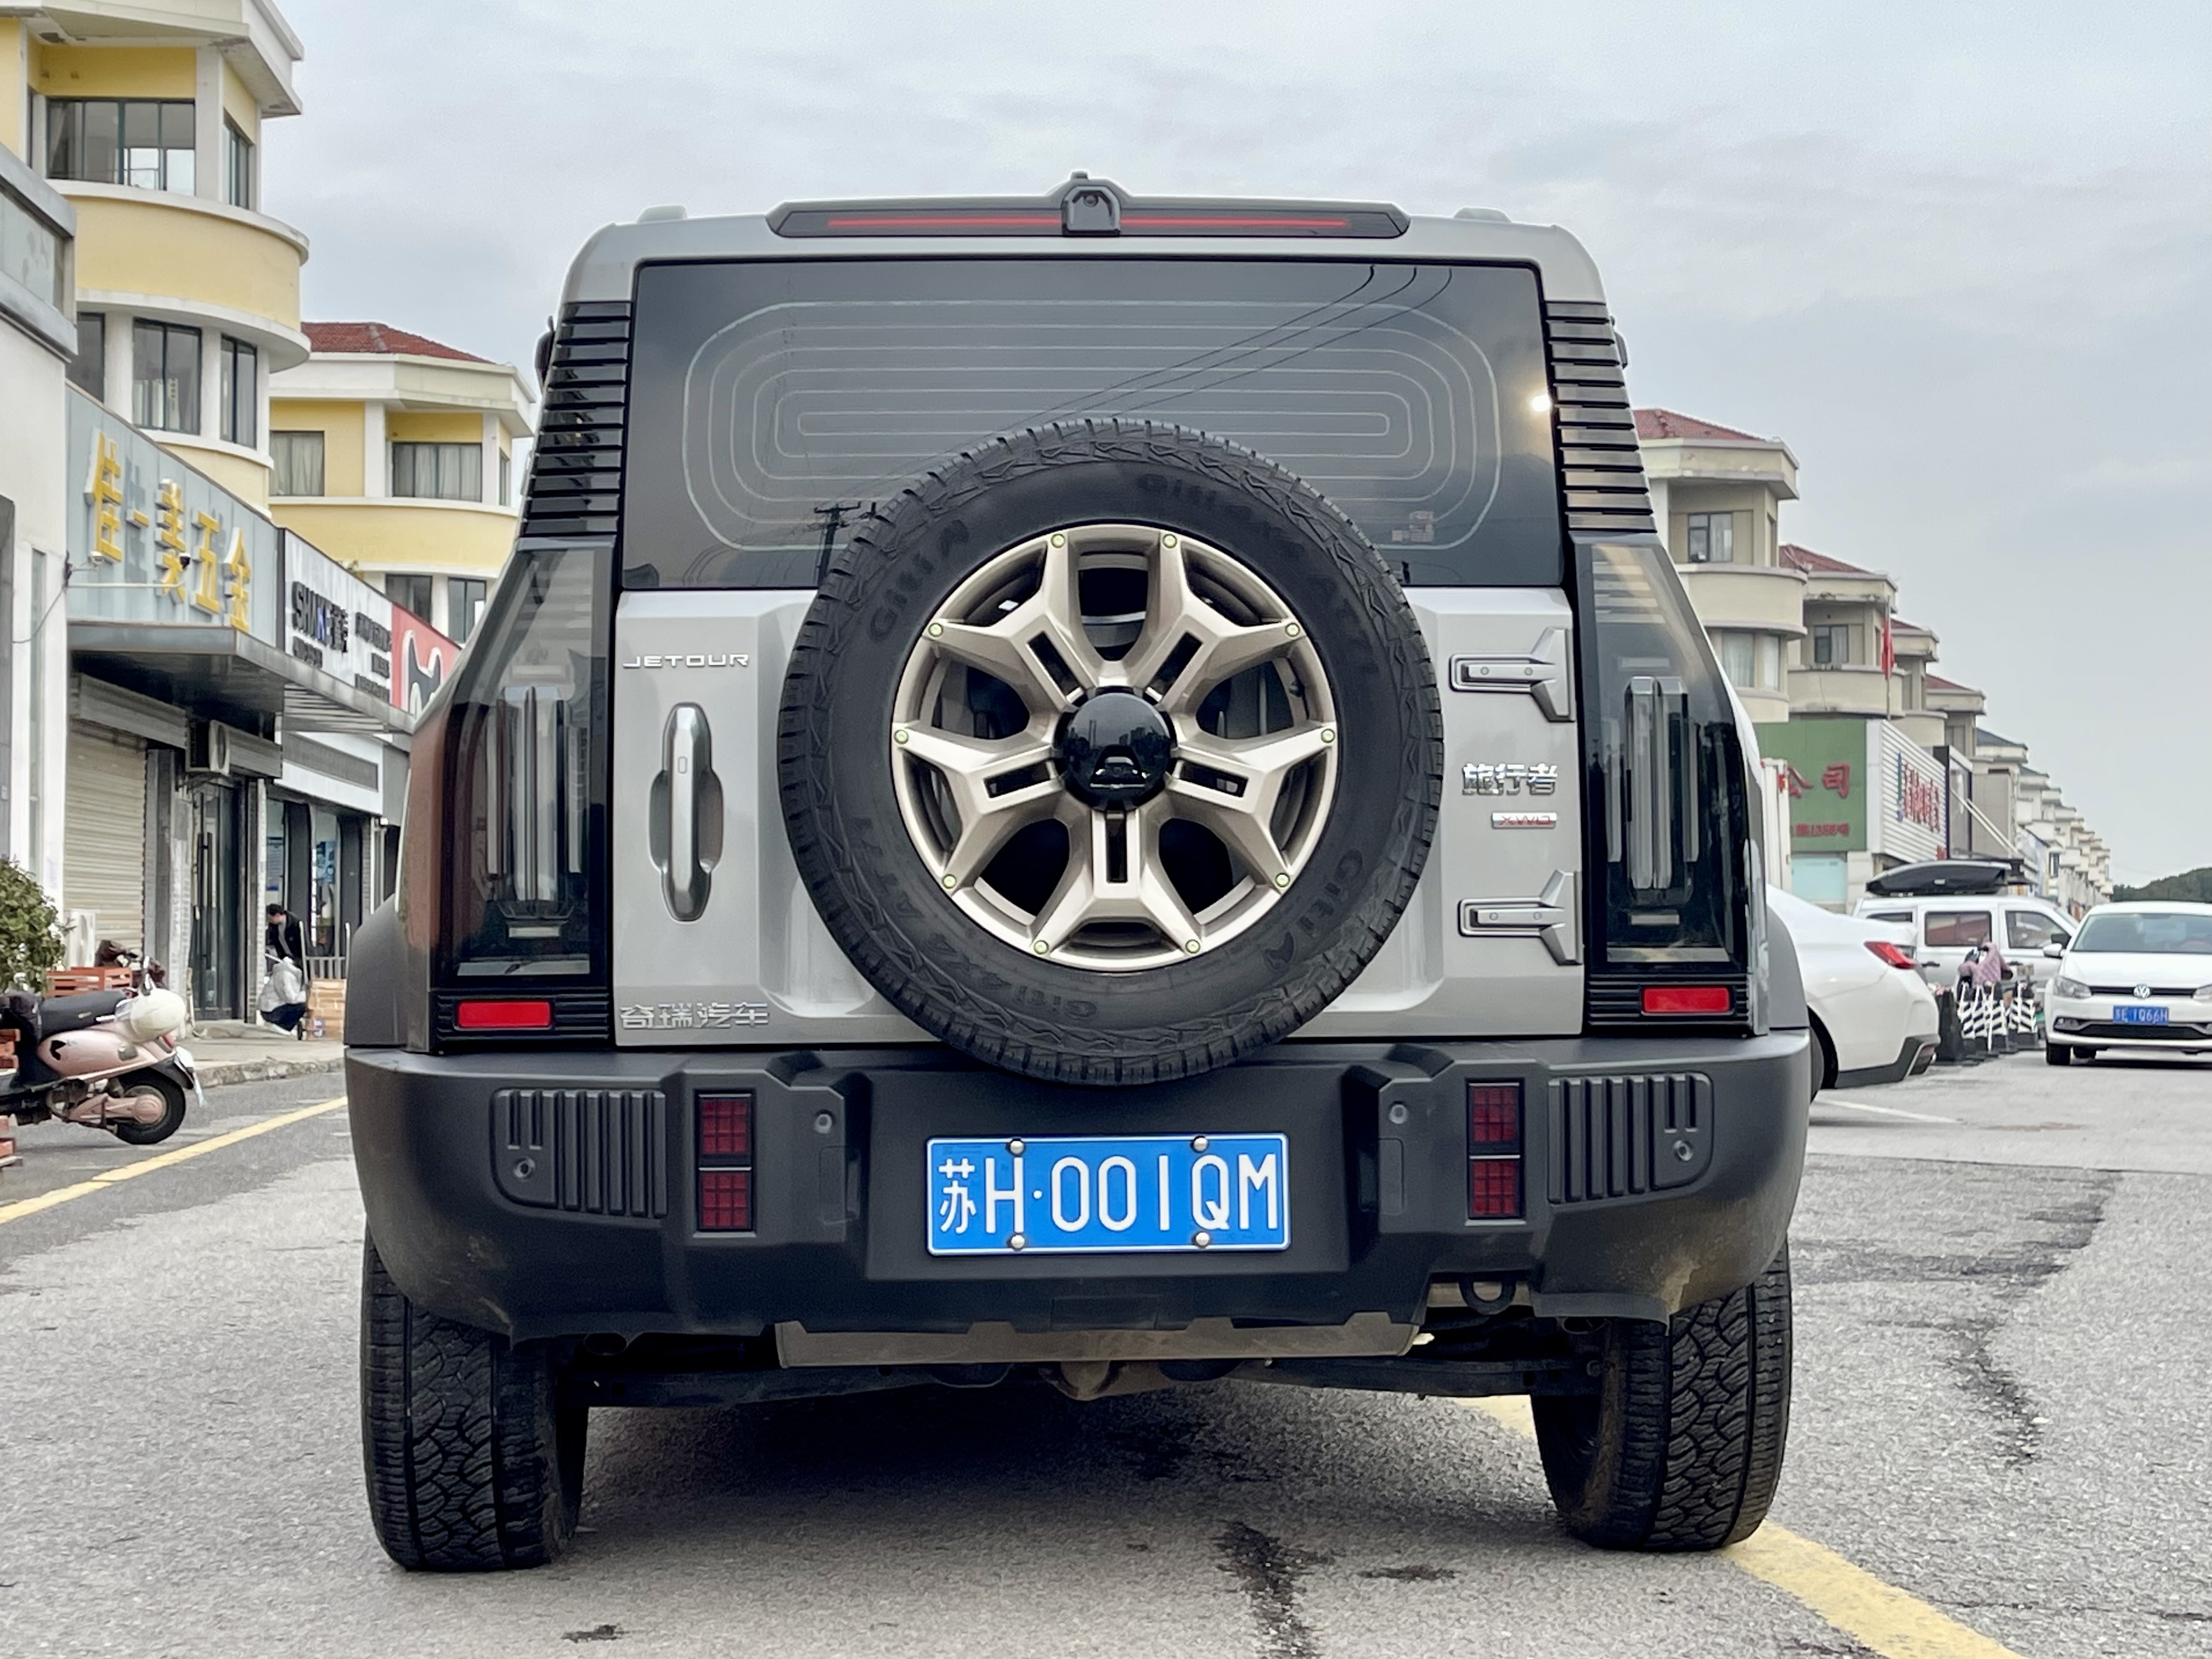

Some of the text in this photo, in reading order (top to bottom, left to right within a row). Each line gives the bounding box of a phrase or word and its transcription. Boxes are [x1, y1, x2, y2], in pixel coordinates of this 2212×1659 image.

[623, 654, 749, 668] JETOUR
[620, 1001, 769, 1029] 奇瑞汽车
[938, 1153, 1278, 1234] 苏H·001QM
